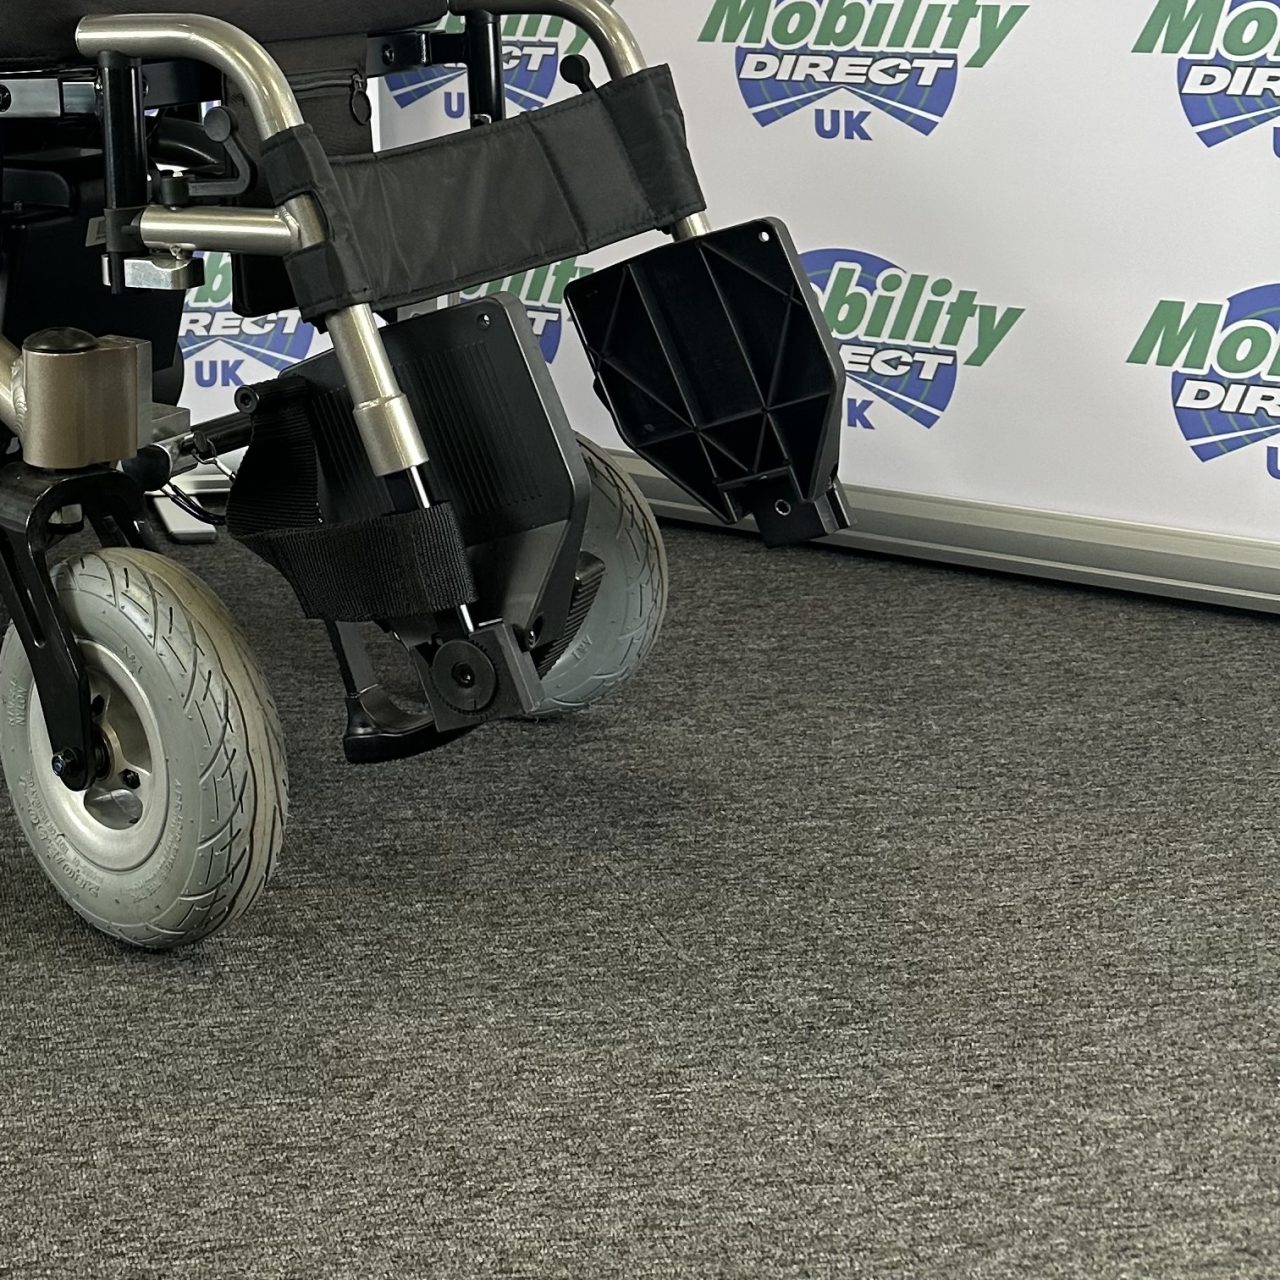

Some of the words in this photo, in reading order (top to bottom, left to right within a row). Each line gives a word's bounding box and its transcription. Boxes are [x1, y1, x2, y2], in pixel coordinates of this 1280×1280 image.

[738, 52, 954, 87] DIRECT
[814, 108, 873, 141] UK
[823, 267, 1026, 368] bility
[194, 359, 246, 389] UK
